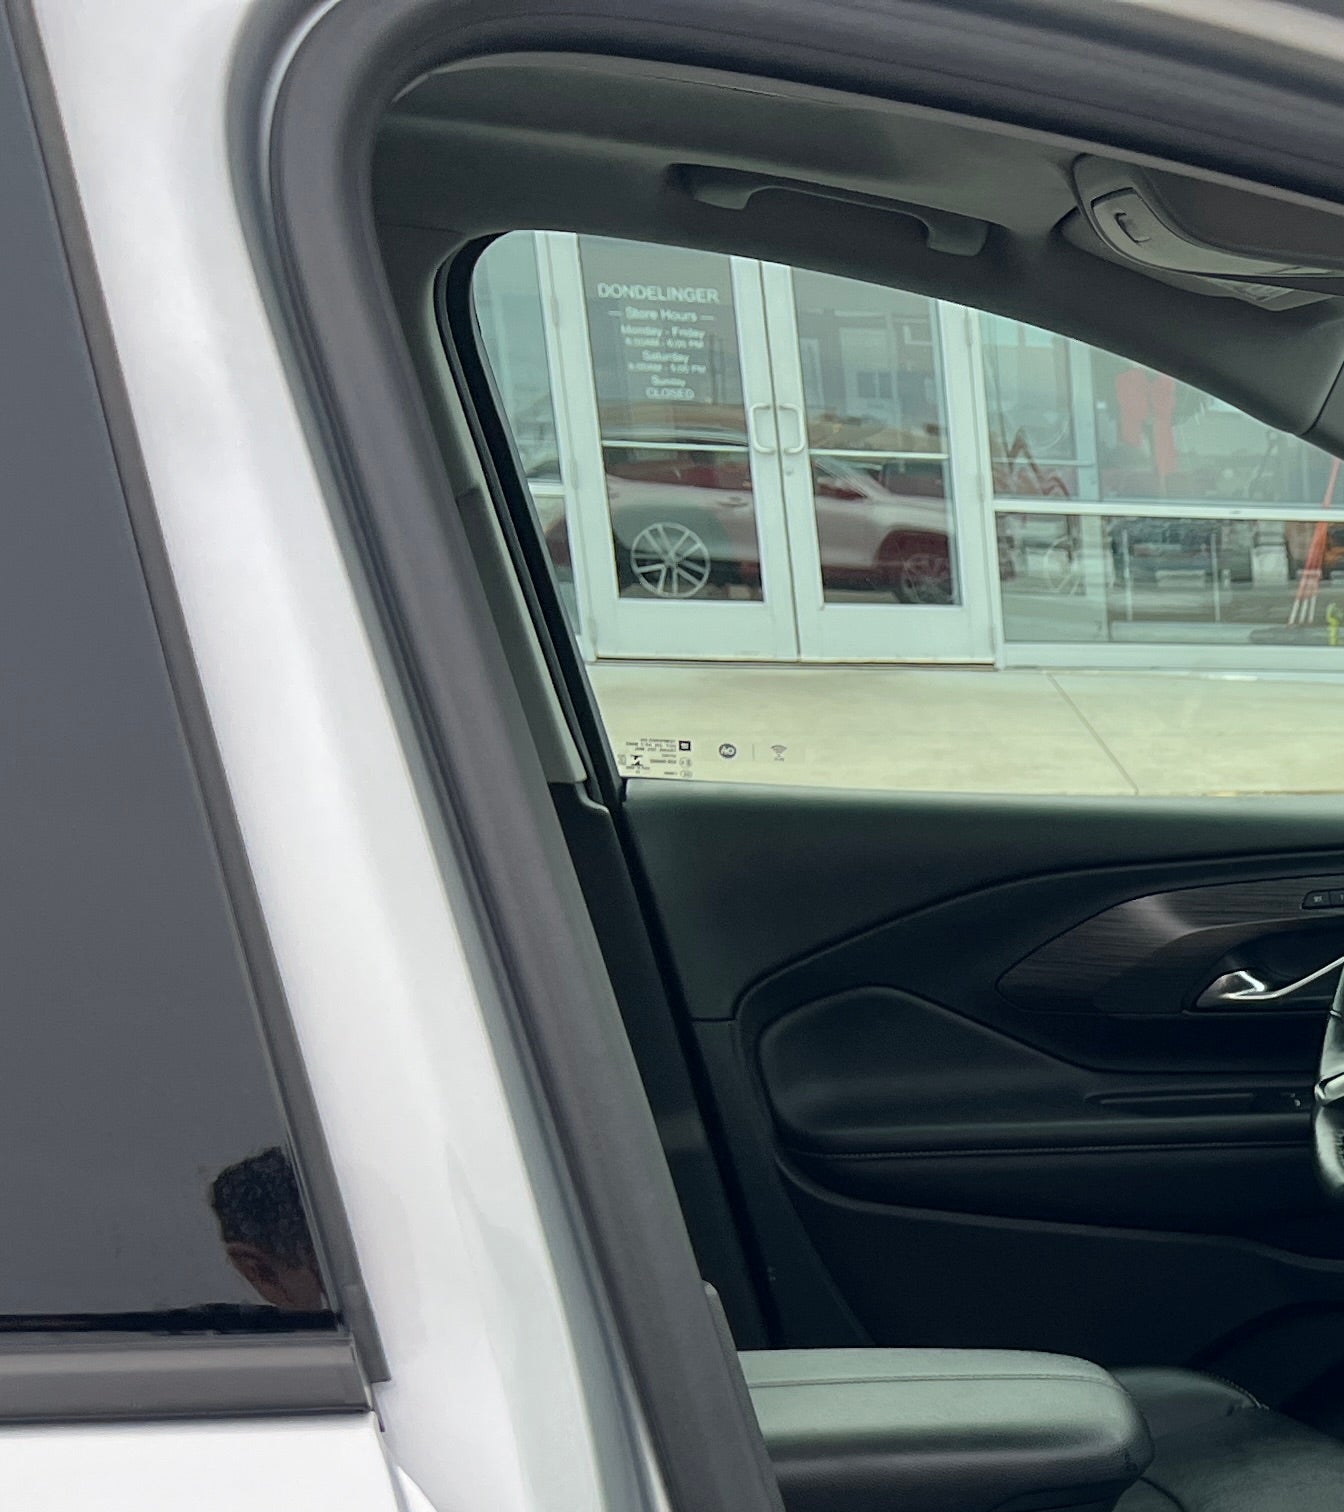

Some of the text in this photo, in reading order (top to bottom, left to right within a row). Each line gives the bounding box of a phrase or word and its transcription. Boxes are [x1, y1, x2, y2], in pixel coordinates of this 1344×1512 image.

[597, 283, 719, 303] DONDELINGER
[625, 305, 698, 322] Store Hours
[645, 386, 696, 401] CLOSED
